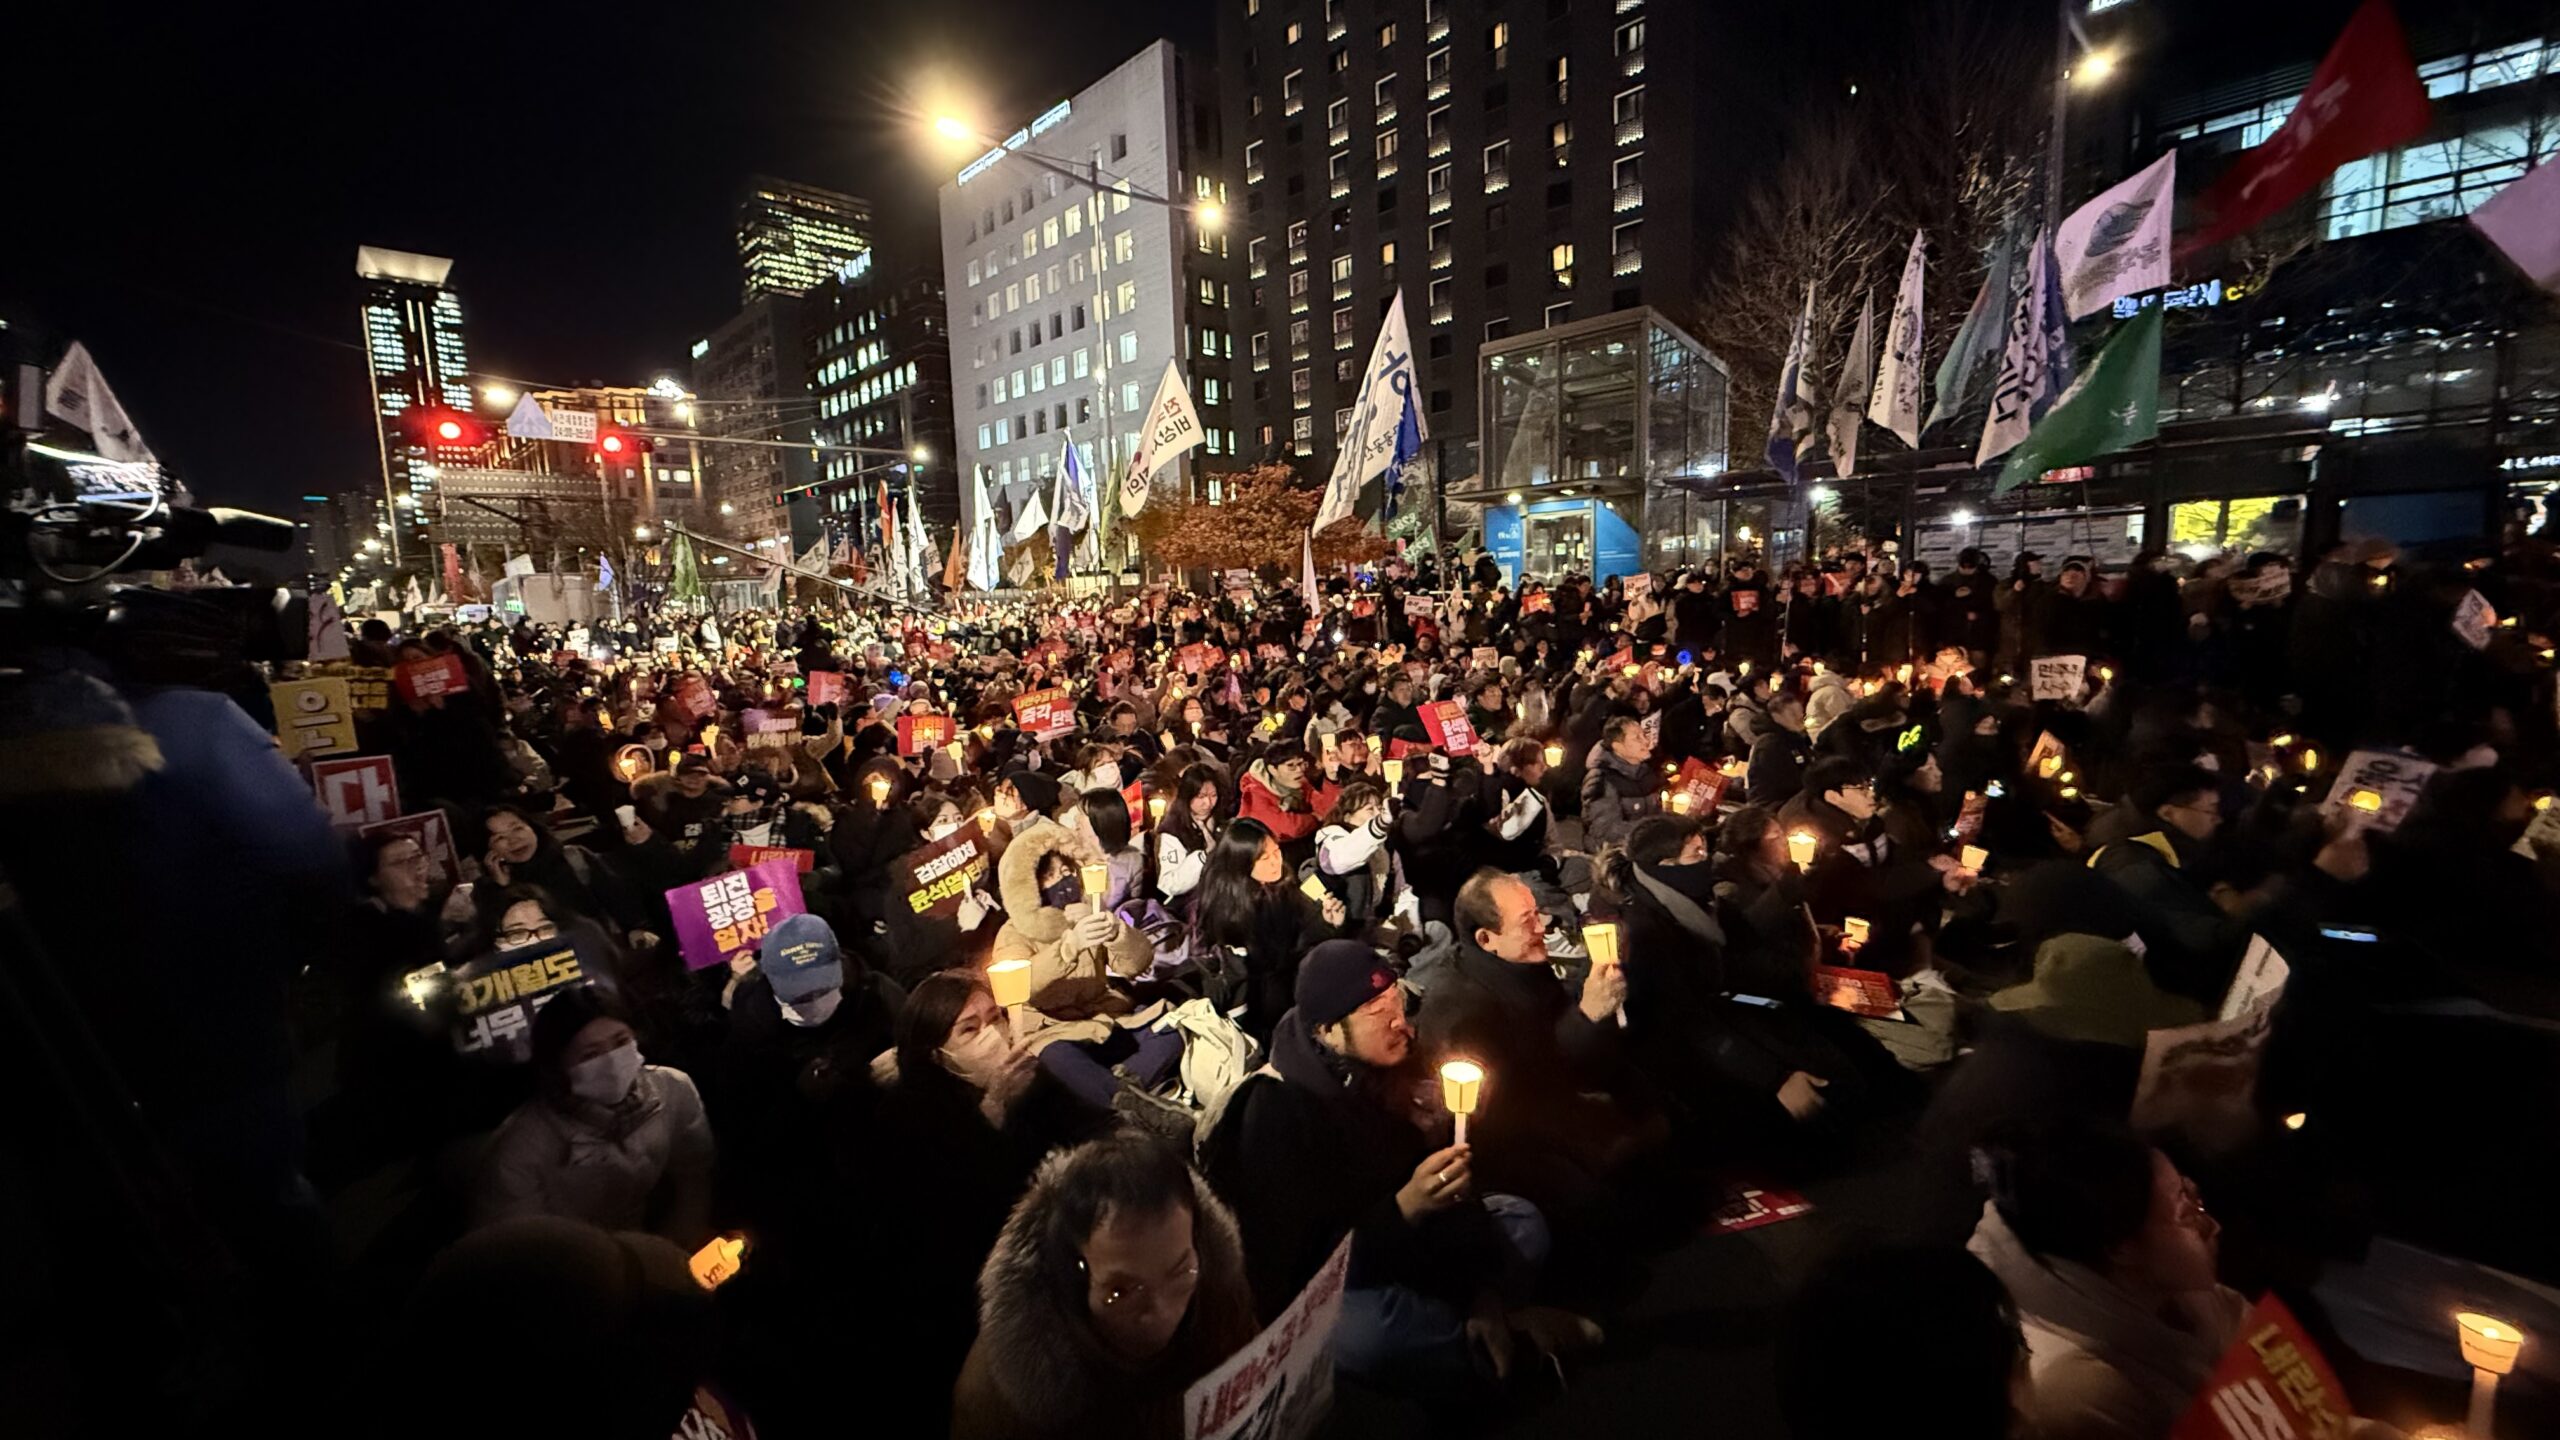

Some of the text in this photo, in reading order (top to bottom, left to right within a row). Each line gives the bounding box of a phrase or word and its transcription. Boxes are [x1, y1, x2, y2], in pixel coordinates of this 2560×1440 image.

[913, 839, 978, 885] 검찰해체
[700, 872, 751, 908] 퇴진
[713, 913, 771, 954] 열자!
[455, 949, 583, 1013] 3개월도
